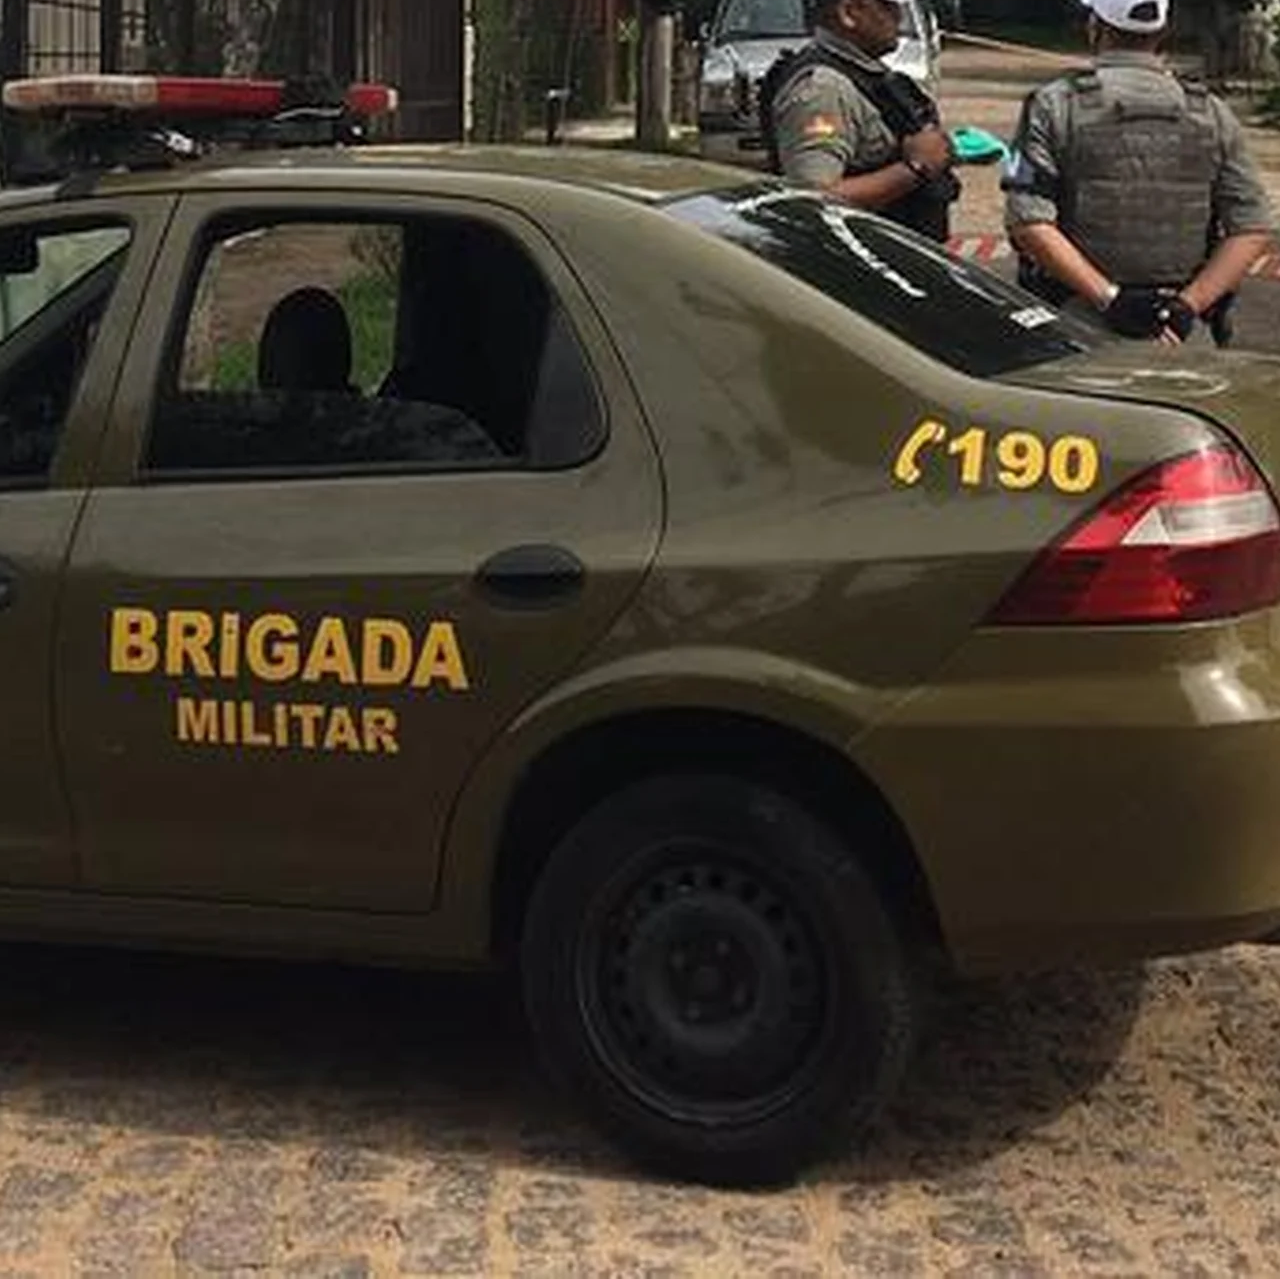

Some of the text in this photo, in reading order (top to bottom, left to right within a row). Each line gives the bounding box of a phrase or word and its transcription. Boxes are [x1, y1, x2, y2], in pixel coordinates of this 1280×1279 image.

[947, 426, 1099, 493] 190
[109, 607, 470, 691] BRIGADA
[176, 696, 400, 754] MILITAR
